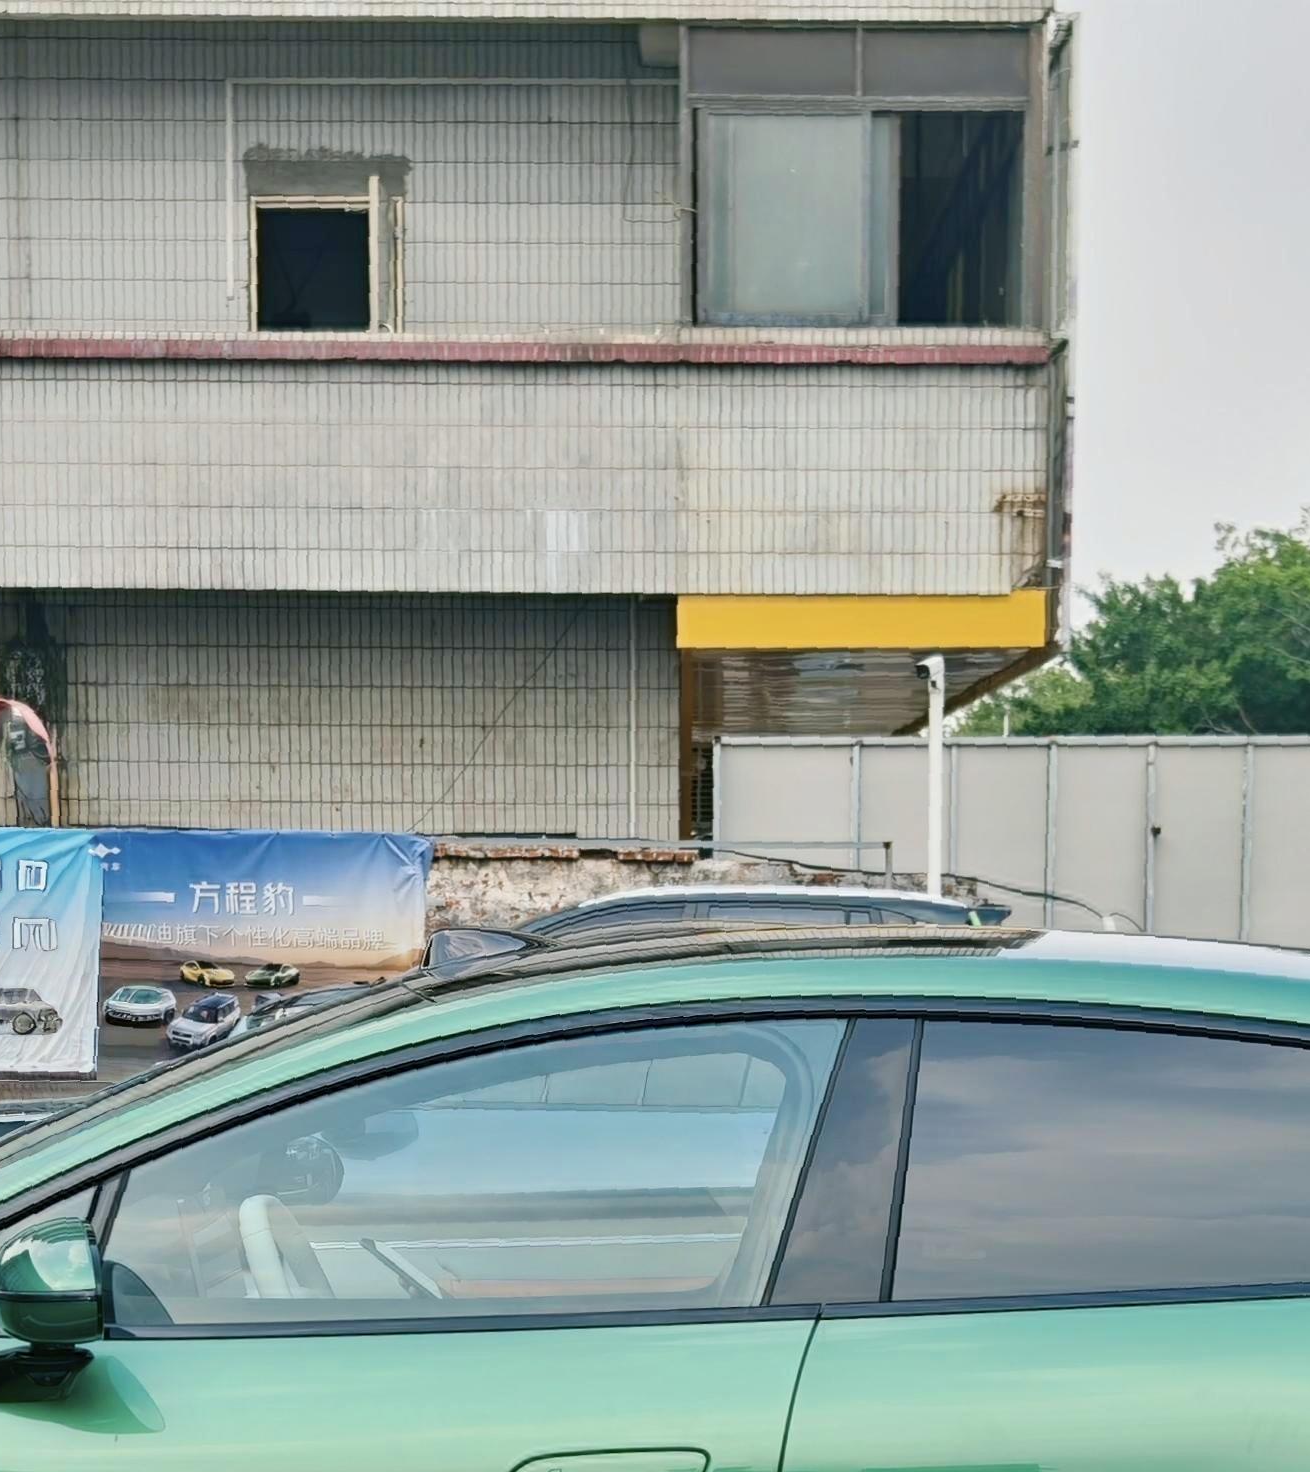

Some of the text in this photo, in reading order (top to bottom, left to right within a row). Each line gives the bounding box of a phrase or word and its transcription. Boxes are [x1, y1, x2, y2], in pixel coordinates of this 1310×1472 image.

[190, 881, 295, 916] 方程豹
[102, 921, 385, 951] 迪旗下个性化高端品牌
